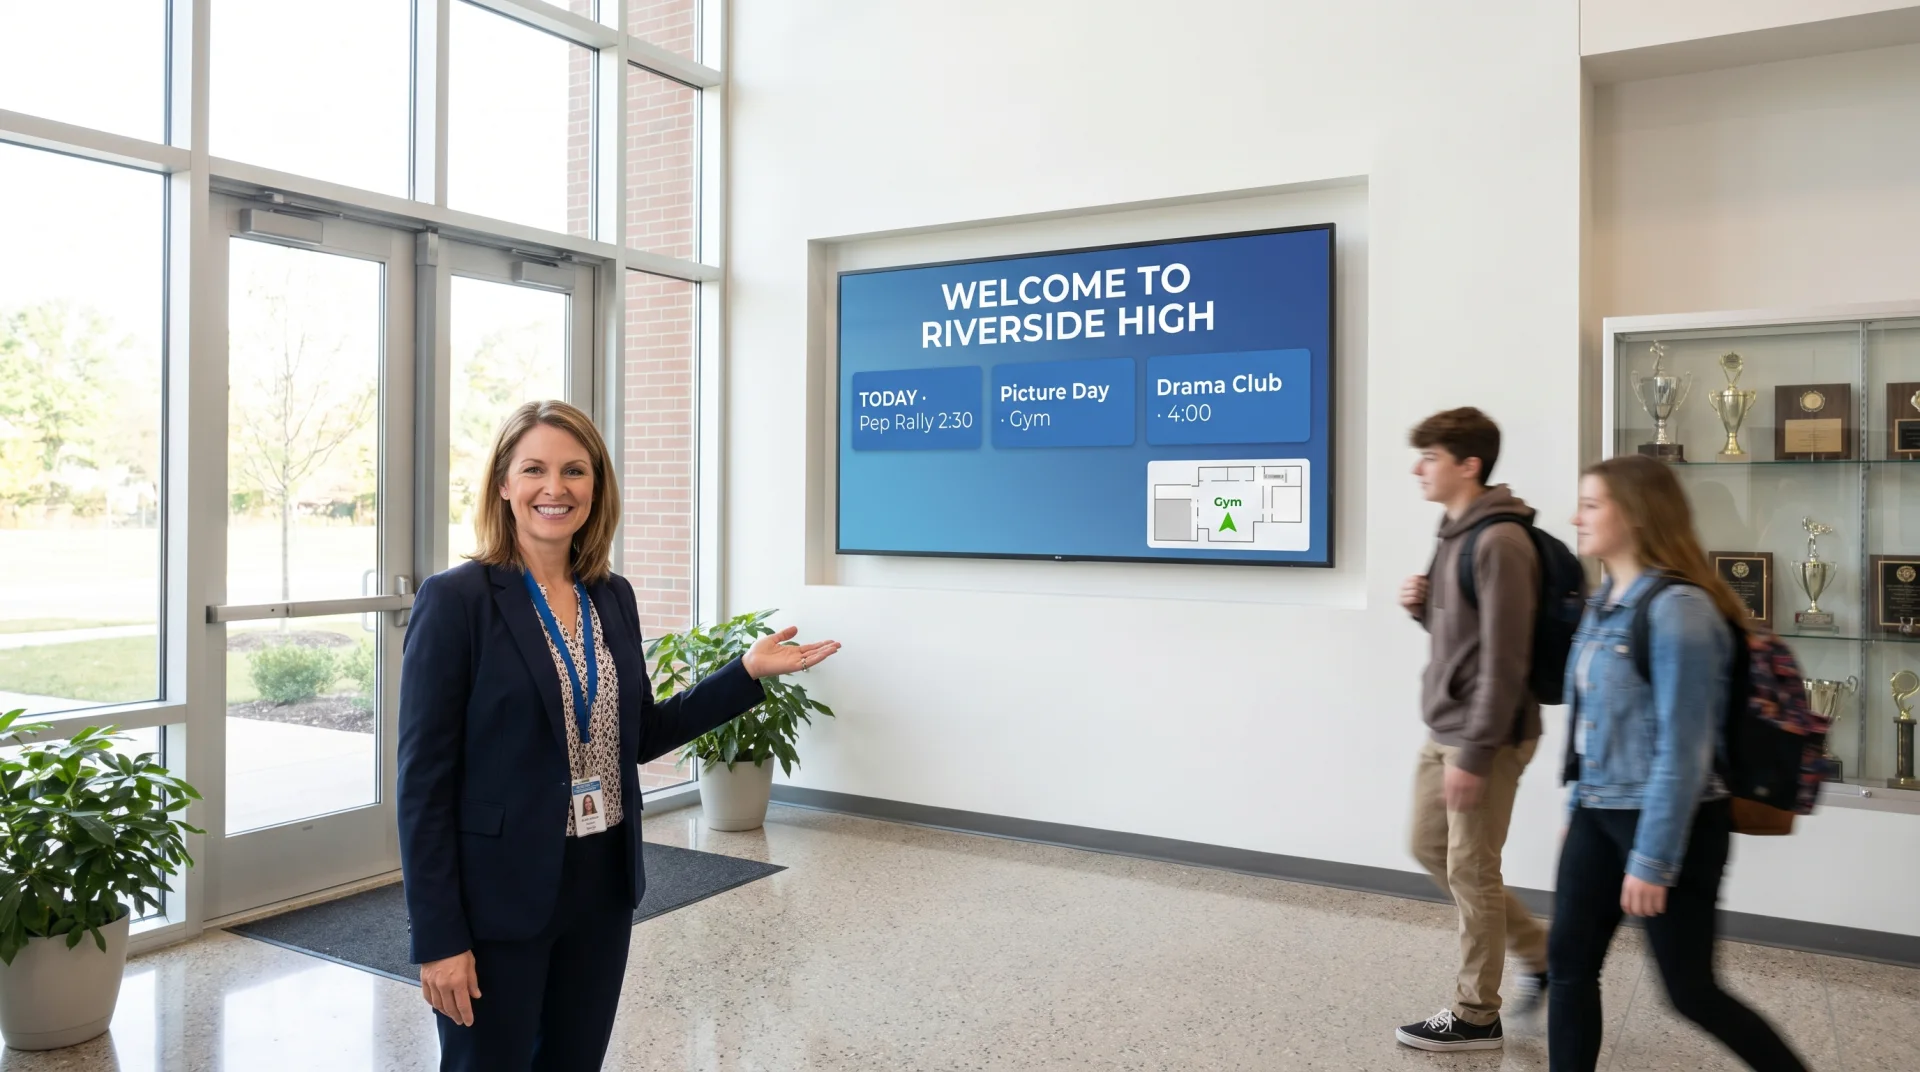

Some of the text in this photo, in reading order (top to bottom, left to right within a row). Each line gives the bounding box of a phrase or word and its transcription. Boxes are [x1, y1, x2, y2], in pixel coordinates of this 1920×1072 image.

[941, 262, 1191, 311] WELCOME TO
[922, 300, 1214, 349] RIVERSIDE HIGH
[1000, 382, 1110, 403] Picture Day
[1157, 372, 1283, 396] Drama Club
[859, 389, 918, 408] TODAY
[859, 411, 973, 434] Pep Rally 2:30
[1009, 410, 1051, 431] Gym
[1167, 403, 1212, 422] 4:00
[1214, 497, 1243, 509] Gym
